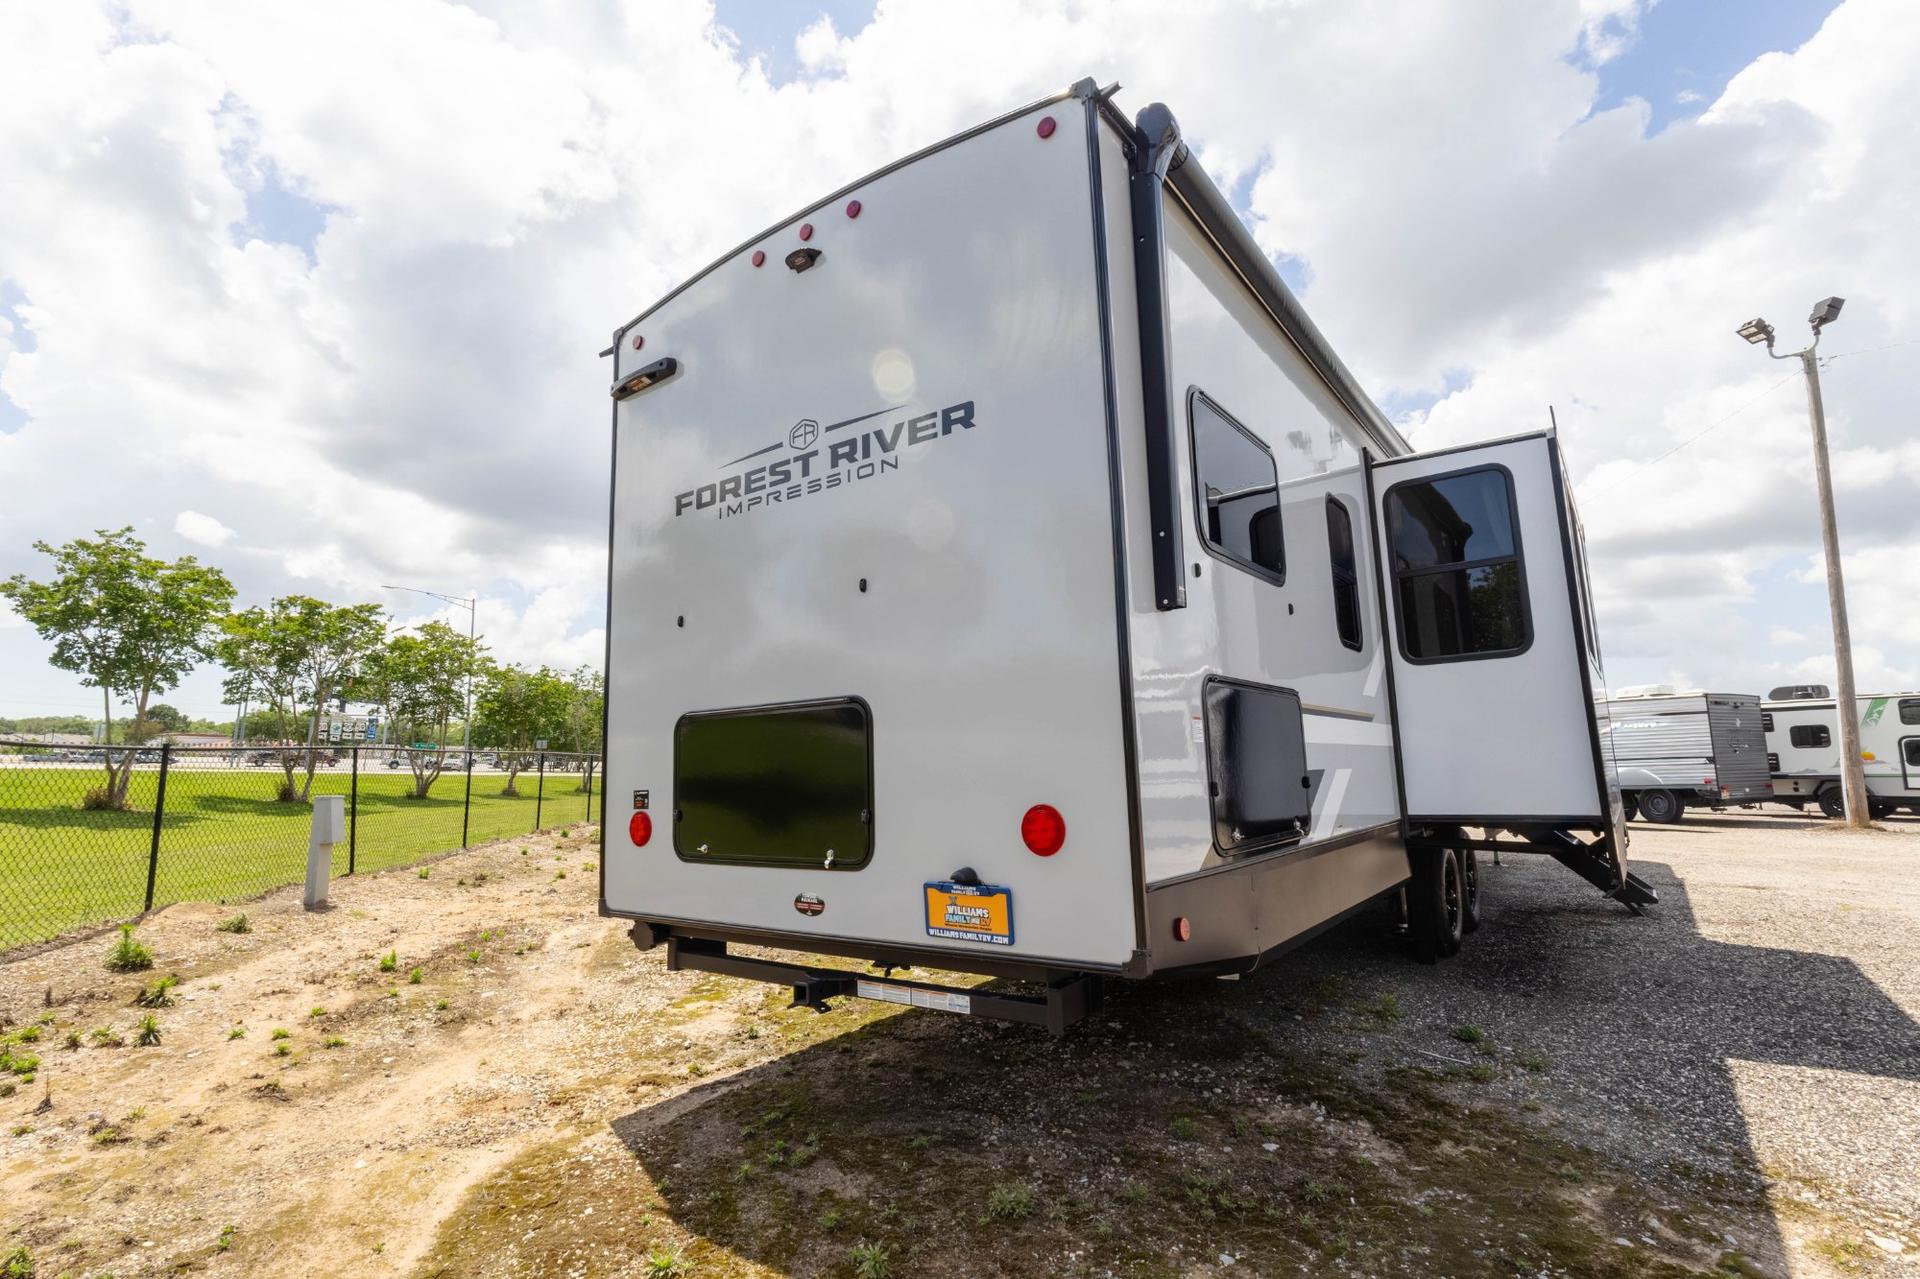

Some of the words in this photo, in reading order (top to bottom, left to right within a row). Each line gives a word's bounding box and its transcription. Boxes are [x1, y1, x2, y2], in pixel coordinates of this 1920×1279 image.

[674, 450, 819, 517] FOREST
[828, 400, 976, 469] RIVER
[718, 455, 899, 520] IMPRESSION
[945, 914, 970, 924] FAMILY
[946, 905, 989, 917] WILLIAMS
